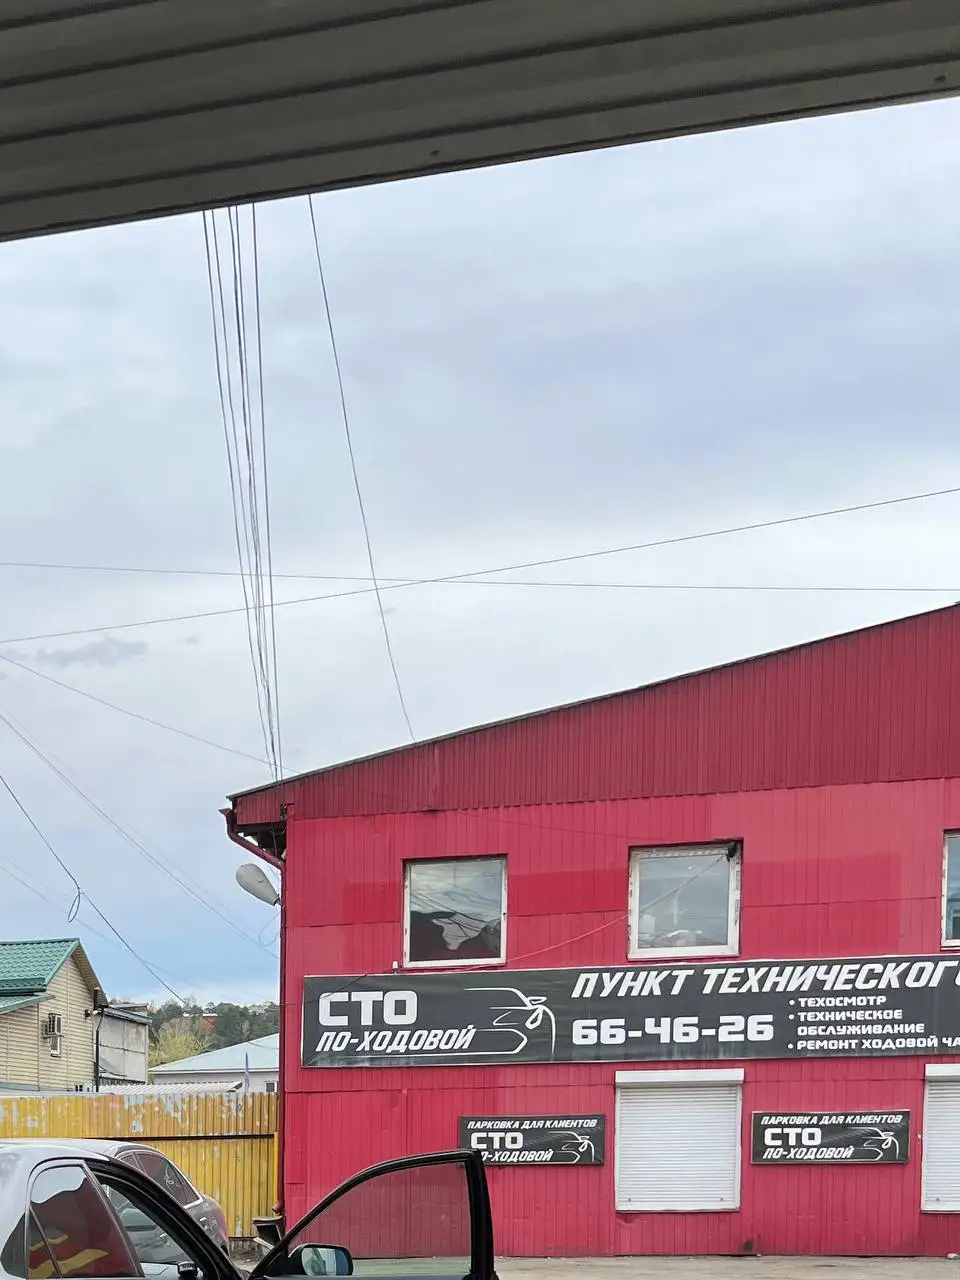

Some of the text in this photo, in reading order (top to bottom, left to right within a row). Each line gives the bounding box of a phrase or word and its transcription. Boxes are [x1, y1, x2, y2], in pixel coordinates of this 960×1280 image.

[570, 969, 694, 999] ПУНКТ
[318, 990, 418, 1026] СТО
[797, 995, 887, 1008] ТЕХОСМОТР
[797, 1009, 903, 1022] ТЕХНИЧЕСКОЕ
[572, 1014, 775, 1046] 66-46-26
[797, 1023, 925, 1036] ОБСЛУЖИВАНИЕ
[315, 1024, 477, 1053] ПО-ХОДОВОЙ
[796, 1039, 859, 1050] РЕМОНТ
[860, 1035, 938, 1050] ХОДОВОЙ
[467, 1119, 598, 1130] ПАРКОВКА ДЛЯ КЛИЕНТОВ
[761, 1114, 903, 1126] ПАРКОВКА ДЛЯ КЛИЕНТОВ
[470, 1131, 523, 1149] СТО
[764, 1127, 822, 1146] СТО
[481, 1149, 554, 1162] О-ХОДОВОЙ
[762, 1145, 855, 1160] ПО-ХОДОВОЙ
